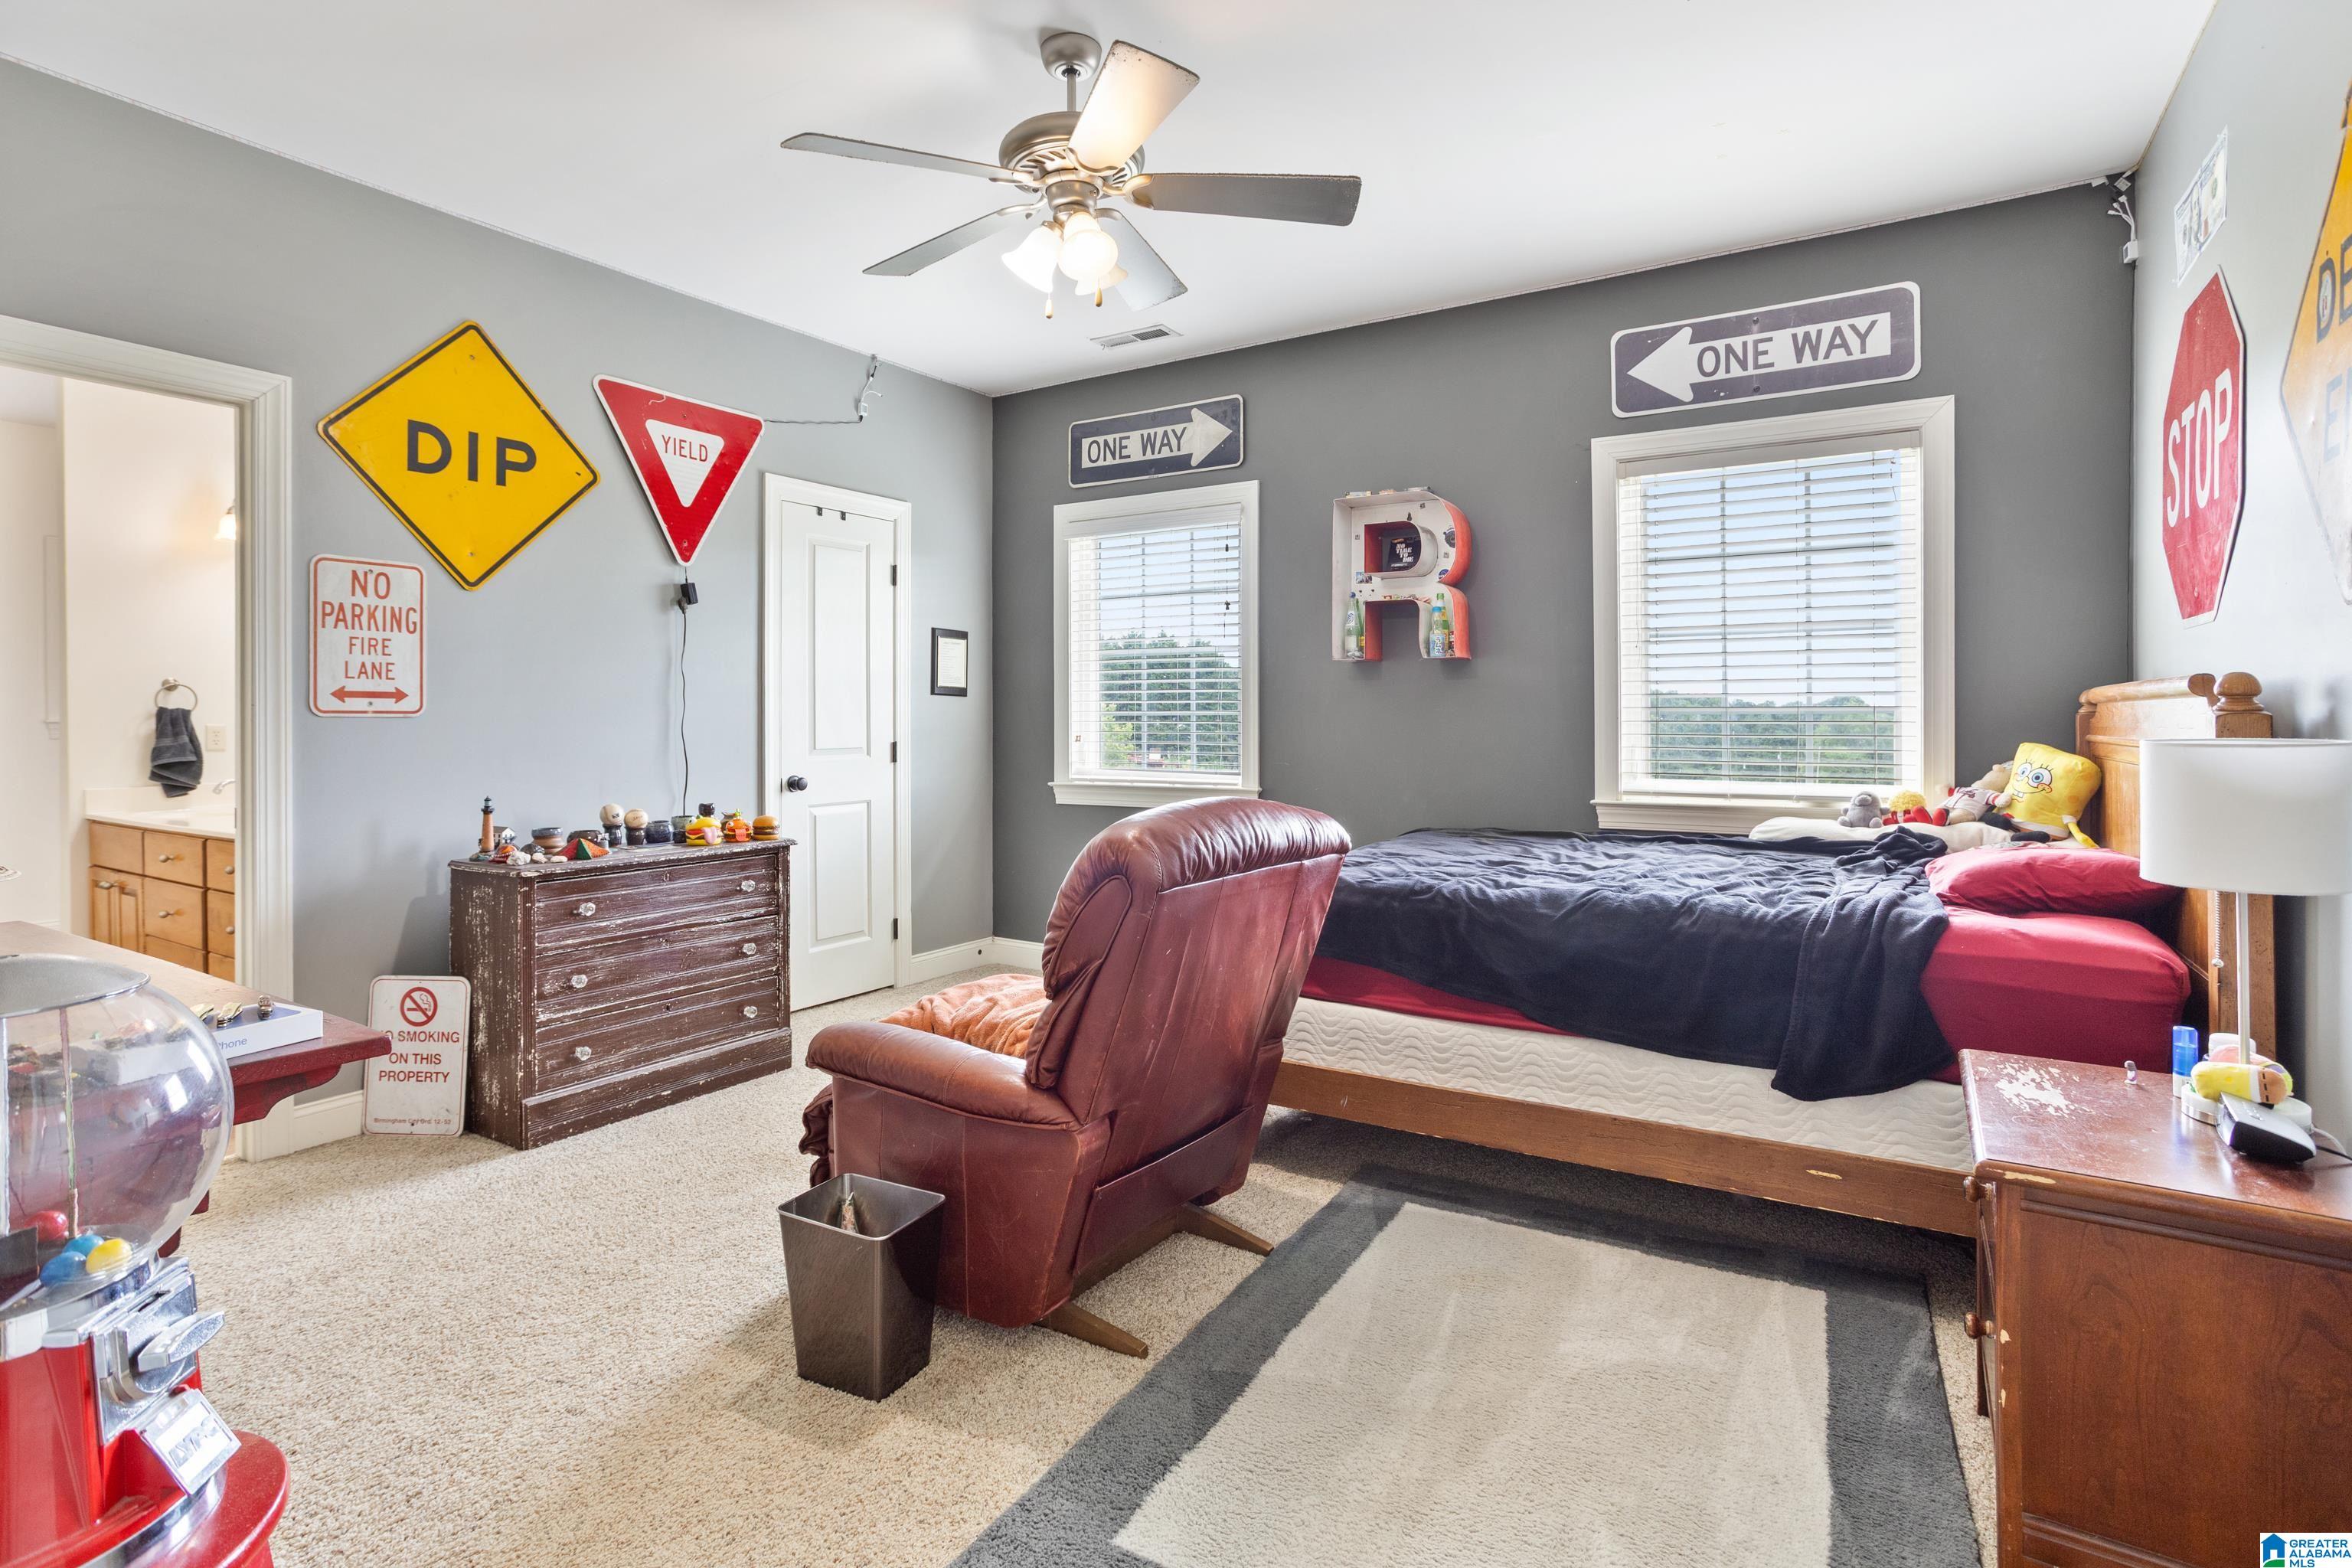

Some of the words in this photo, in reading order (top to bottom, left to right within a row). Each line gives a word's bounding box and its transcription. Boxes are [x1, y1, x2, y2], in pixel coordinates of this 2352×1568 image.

[1697, 336, 1775, 377] ONE
[1791, 318, 1878, 364] WAY
[407, 419, 537, 487] DIP
[662, 433, 708, 463] YIELD
[1087, 435, 1131, 463] ONE
[1140, 426, 1187, 456] WAY
[2166, 368, 2233, 528] STOP
[351, 570, 390, 599] NO
[322, 602, 417, 635] PARKING
[348, 637, 392, 656] FIRE
[345, 662, 396, 680] LANE
[398, 1031, 460, 1043] SMOKING
[389, 1052, 408, 1064] ON
[412, 1053, 442, 1065] THIS
[378, 1070, 450, 1083] PROPERTY
